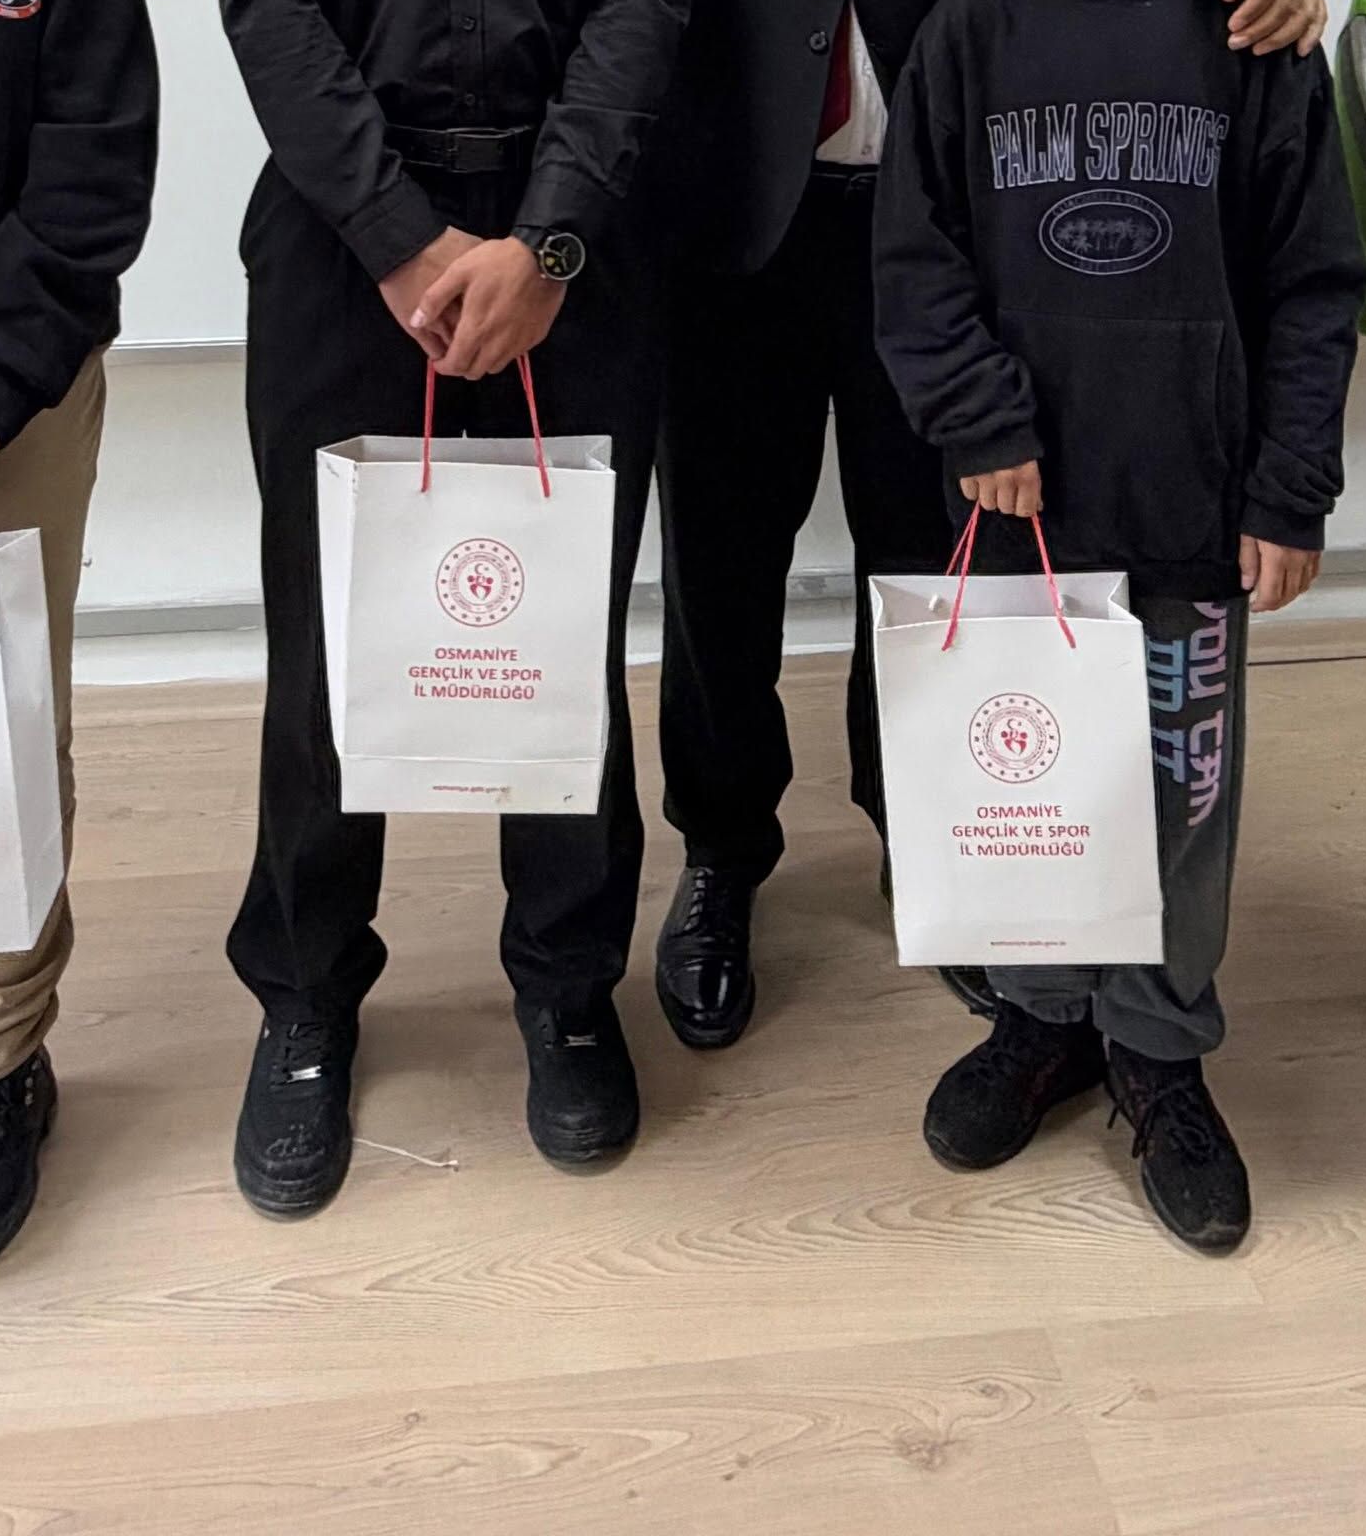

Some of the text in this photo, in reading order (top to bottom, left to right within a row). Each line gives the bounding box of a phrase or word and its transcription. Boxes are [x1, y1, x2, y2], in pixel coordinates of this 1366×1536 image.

[985, 103, 1077, 189] PALM
[435, 647, 518, 661] OSMANİYE
[408, 665, 542, 681] GENÇLİK VE SPOR
[414, 682, 535, 700] İL MÜDÜRLÜĞÜ
[977, 803, 1063, 818] OSMANİYE
[952, 823, 1091, 839] GENÇLİK VE SPOR
[960, 840, 1085, 856] İL MÜDÜRLÜĞÜ
